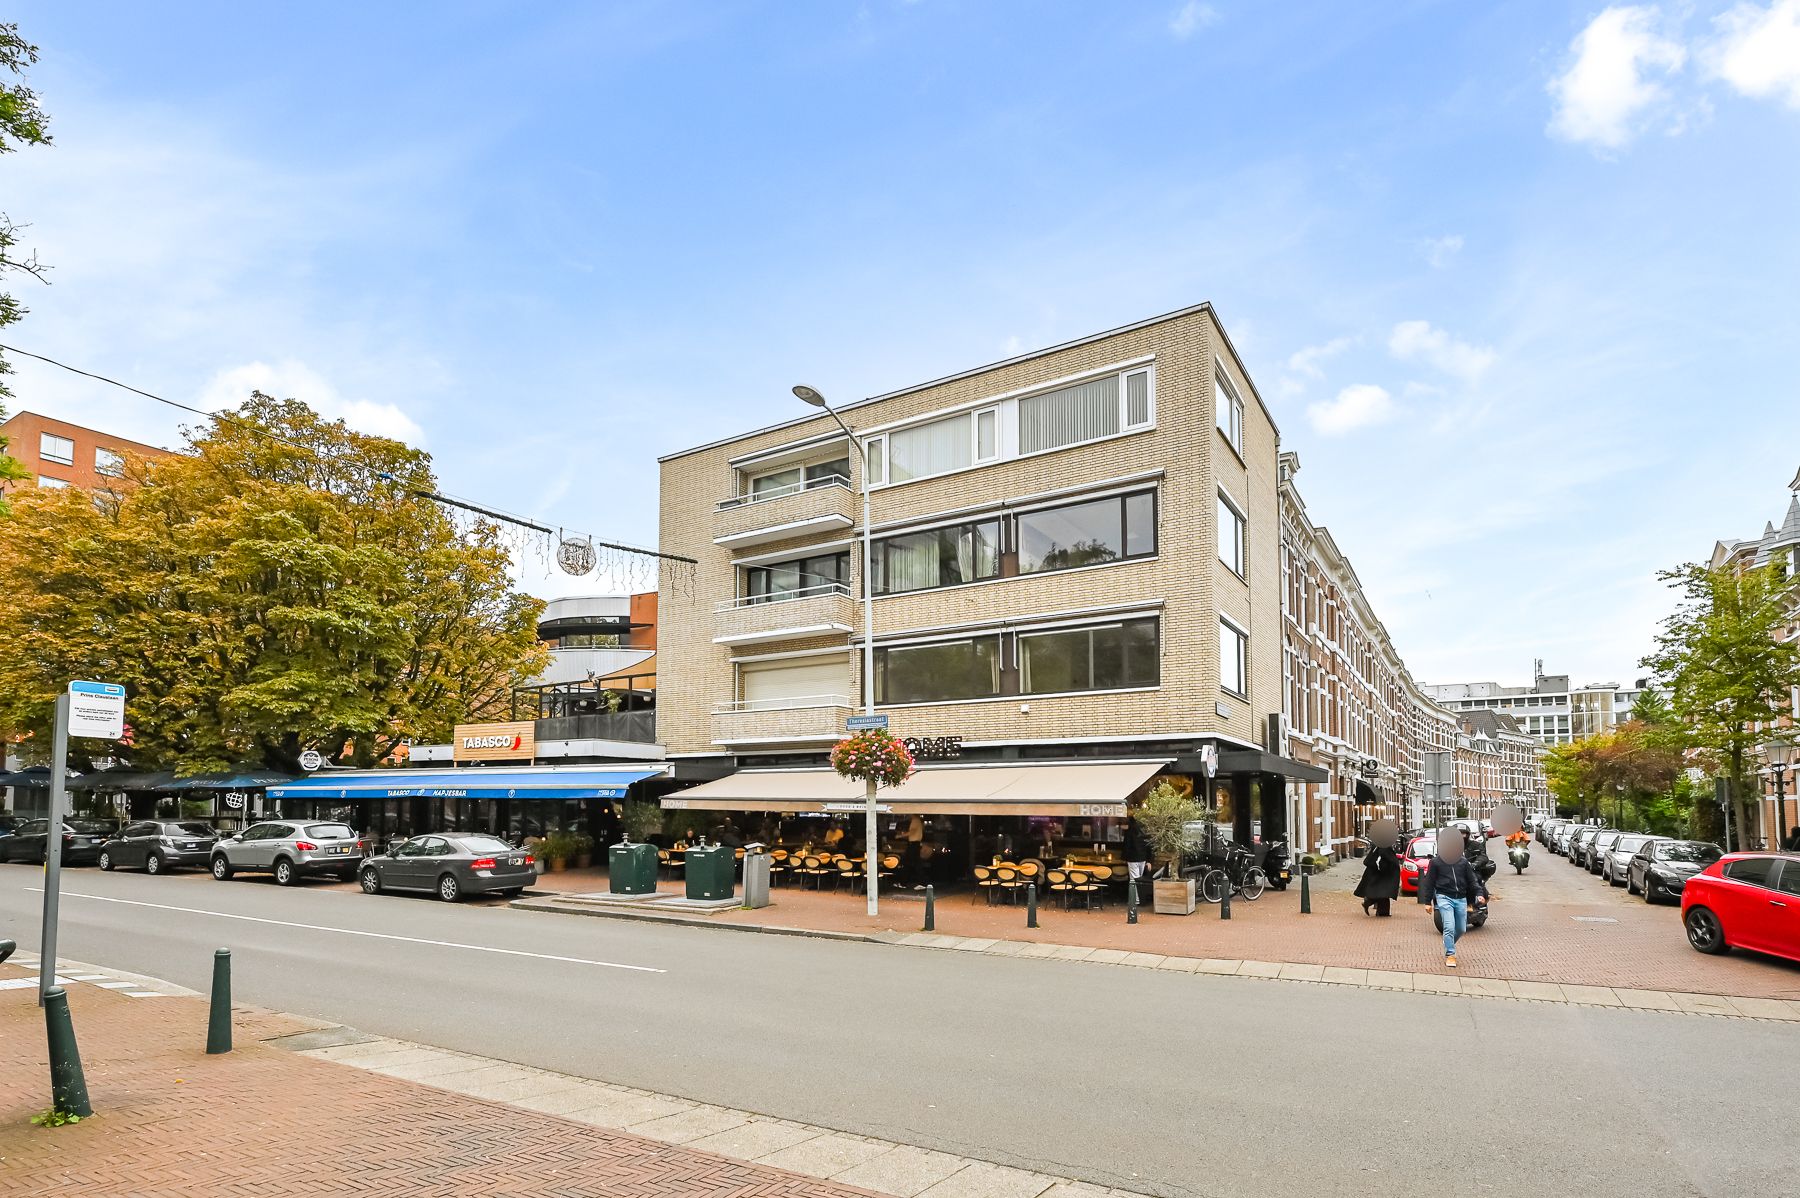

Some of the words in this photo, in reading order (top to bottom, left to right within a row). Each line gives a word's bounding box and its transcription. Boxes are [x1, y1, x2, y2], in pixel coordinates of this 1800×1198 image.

[463, 735, 511, 749] TABASCO
[903, 736, 963, 760] OME
[387, 789, 411, 797] TABASCO
[662, 800, 688, 809] HOME
[1080, 804, 1125, 816] HOME
